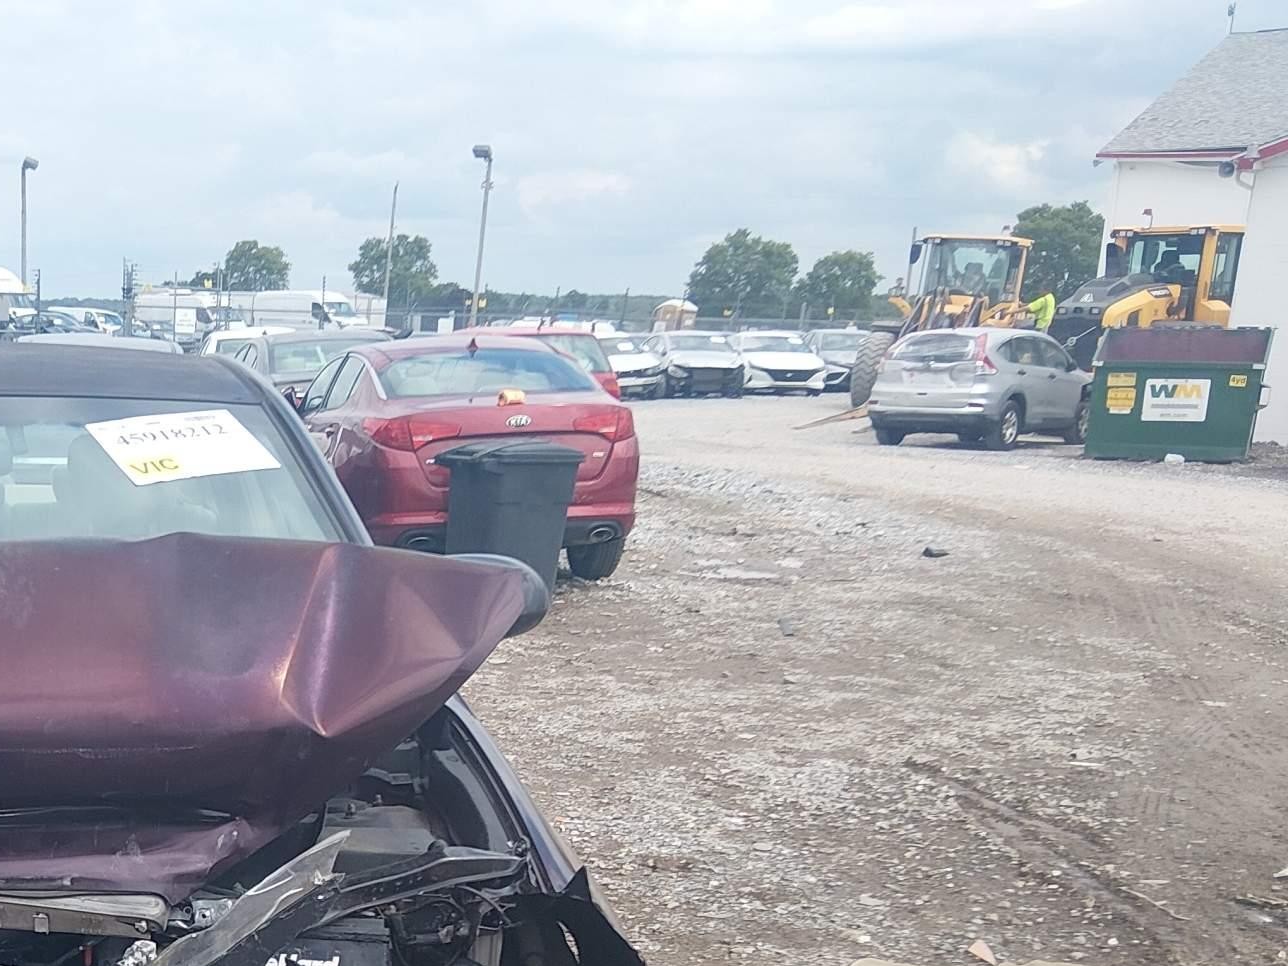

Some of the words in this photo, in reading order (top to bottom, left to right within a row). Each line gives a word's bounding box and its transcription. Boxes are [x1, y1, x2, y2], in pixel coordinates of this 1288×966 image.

[1150, 384, 1202, 399] WM
[509, 415, 529, 427] KIA
[117, 423, 229, 446] 45918212
[129, 458, 180, 475] VIC
